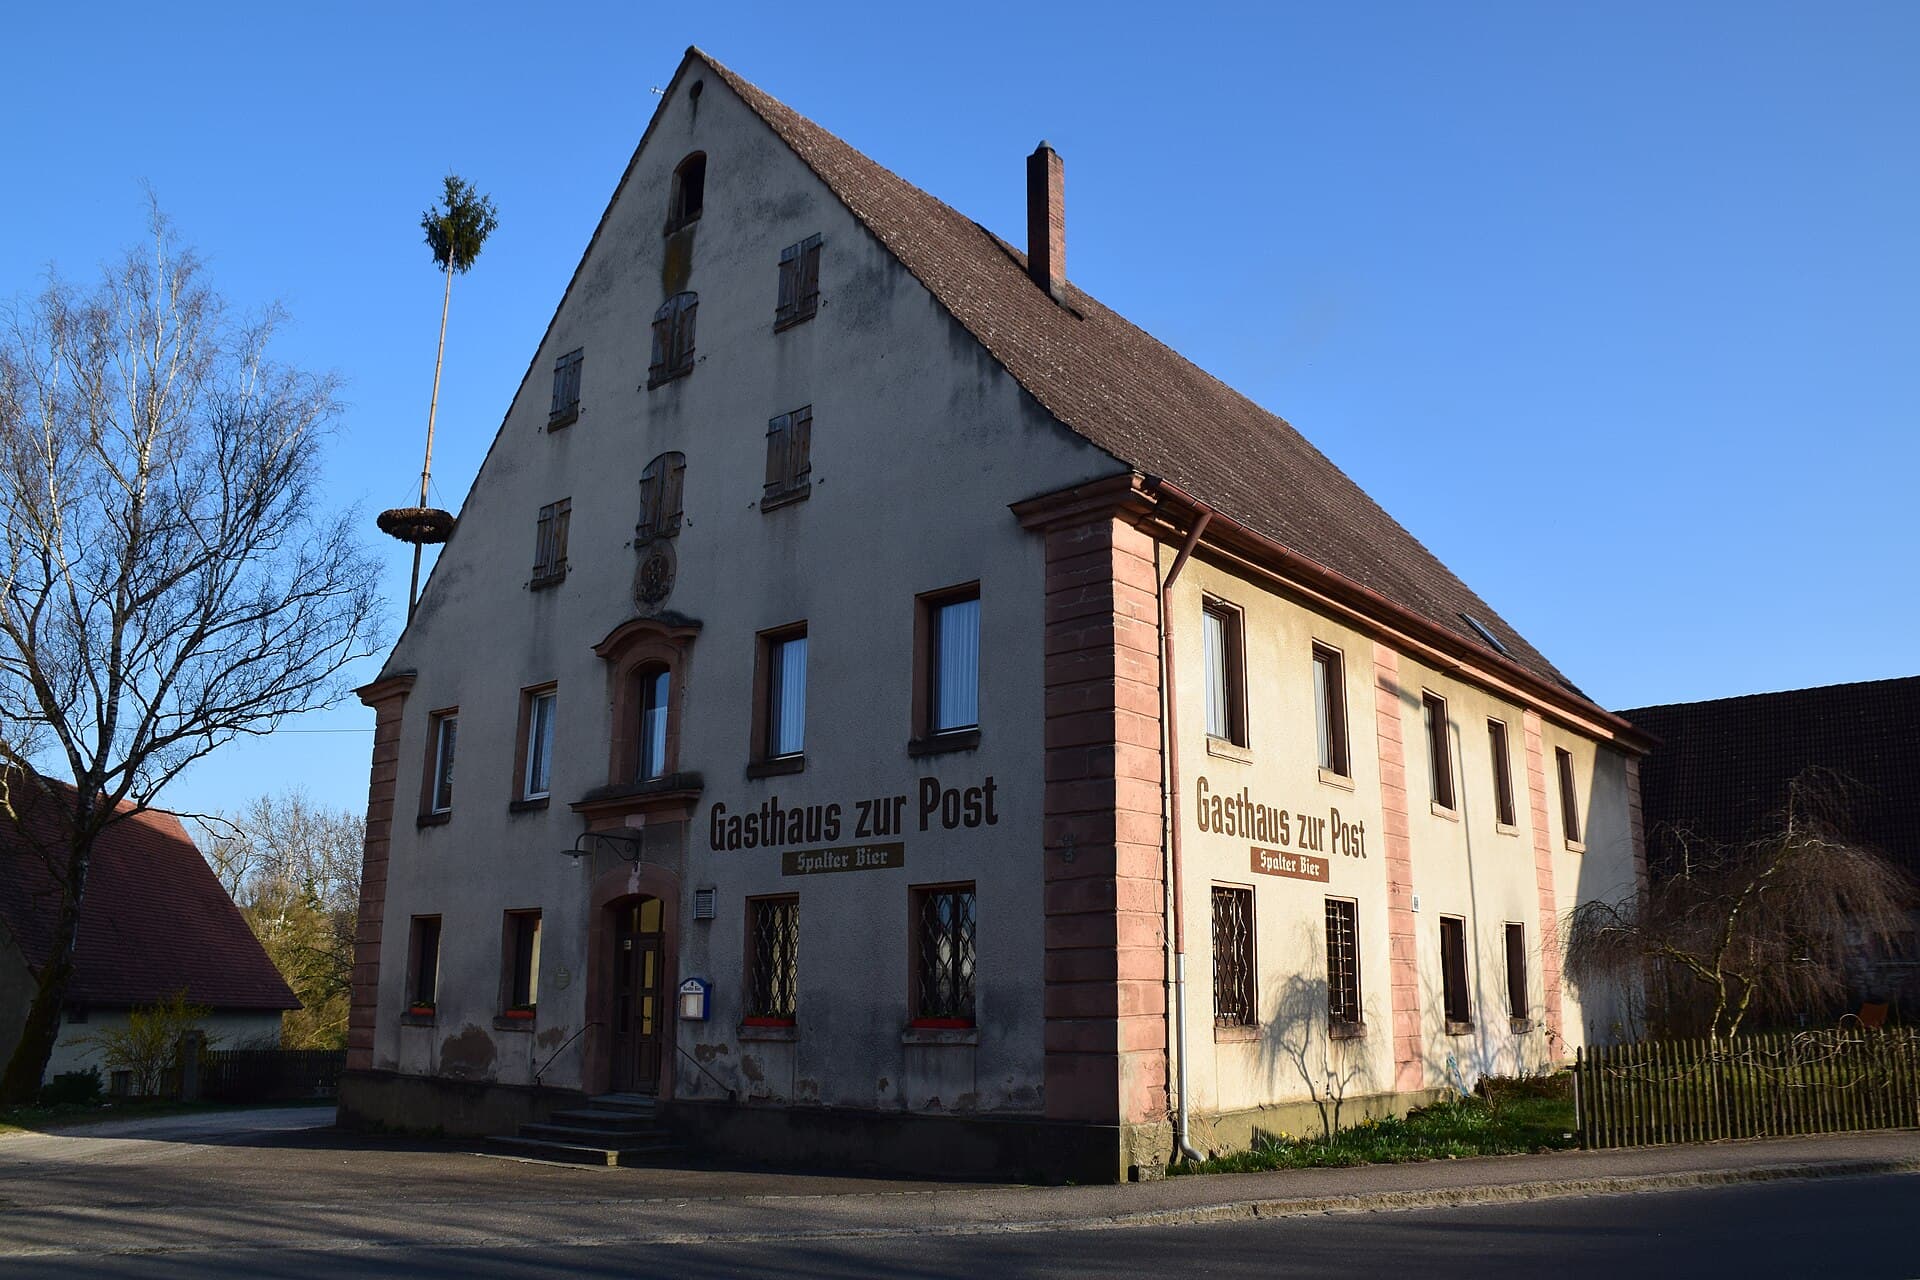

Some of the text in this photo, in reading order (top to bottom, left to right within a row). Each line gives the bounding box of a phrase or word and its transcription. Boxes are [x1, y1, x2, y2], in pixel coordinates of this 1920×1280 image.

[710, 775, 999, 851] Gasthaus zur Post
[1196, 776, 1367, 859] Gasthaus zur Post
[797, 847, 889, 873] Spalter Bier
[1260, 851, 1320, 876] Spalter Bier
